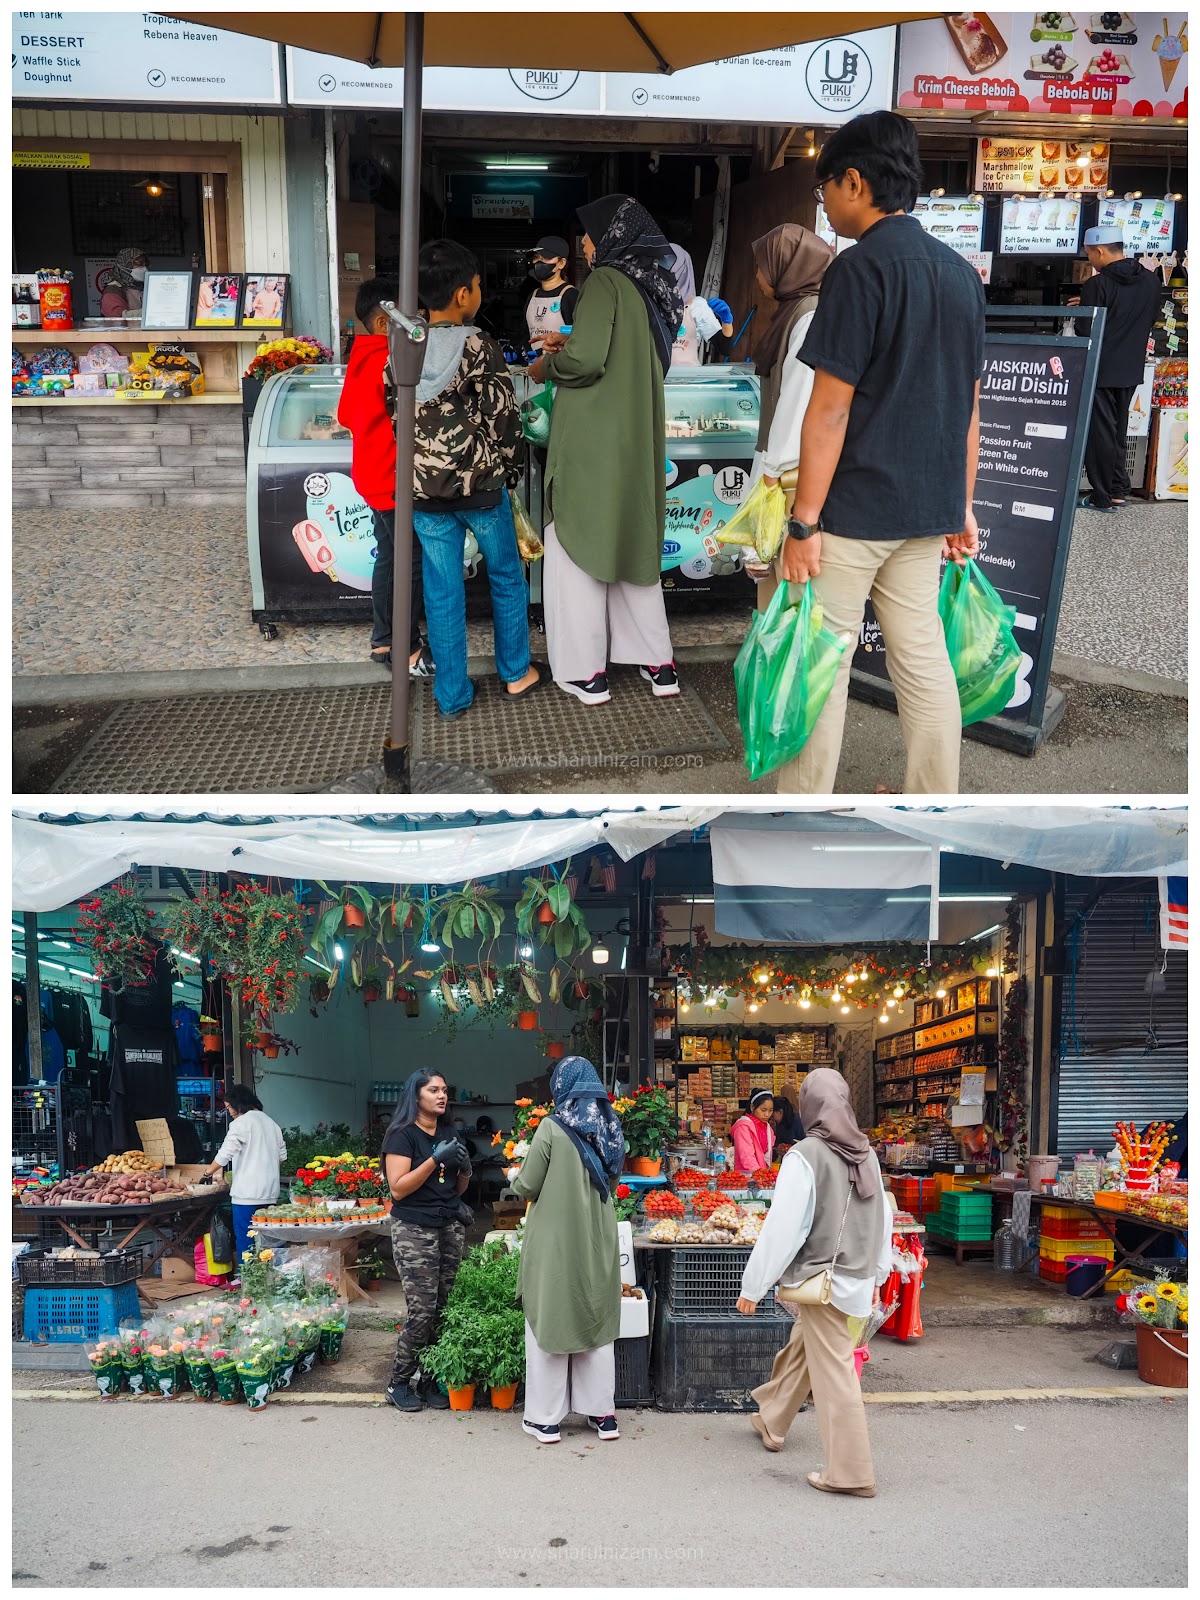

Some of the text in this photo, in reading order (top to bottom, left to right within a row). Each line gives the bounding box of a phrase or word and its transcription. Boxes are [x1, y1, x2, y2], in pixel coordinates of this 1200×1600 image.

[144, 30, 218, 41] Rebena Heaven
[21, 36, 84, 48] DESSERT
[22, 56, 81, 66] Waffle Stick
[753, 57, 791, 66] Ice-cream
[24, 72, 72, 83] Doughnut
[526, 71, 558, 83] PUKU
[341, 81, 393, 89] RECOMMENDED
[822, 84, 851, 96] PUKU
[918, 80, 1016, 97] Krim Cheese Bebola
[653, 94, 701, 102] RECOMMENDED
[1047, 86, 1113, 100] Bebola Ubi
[983, 163, 1033, 171] Marshmallow
[983, 172, 1020, 180] Ice Cream
[982, 182, 1003, 190] RM10
[473, 196, 524, 206] Strawberry
[1056, 238, 1074, 247] RM 7
[989, 360, 1046, 375] AISKRIM
[983, 374, 1069, 395] Jual Disini
[980, 436, 1032, 450] Passion Fruit
[978, 448, 1017, 460] Green Tea
[978, 462, 1048, 478] poh White Coffee
[1014, 504, 1026, 514] RM
[663, 543, 678, 552] STI
[979, 553, 1016, 569] Keledek)
[431, 885, 437, 897] 6
